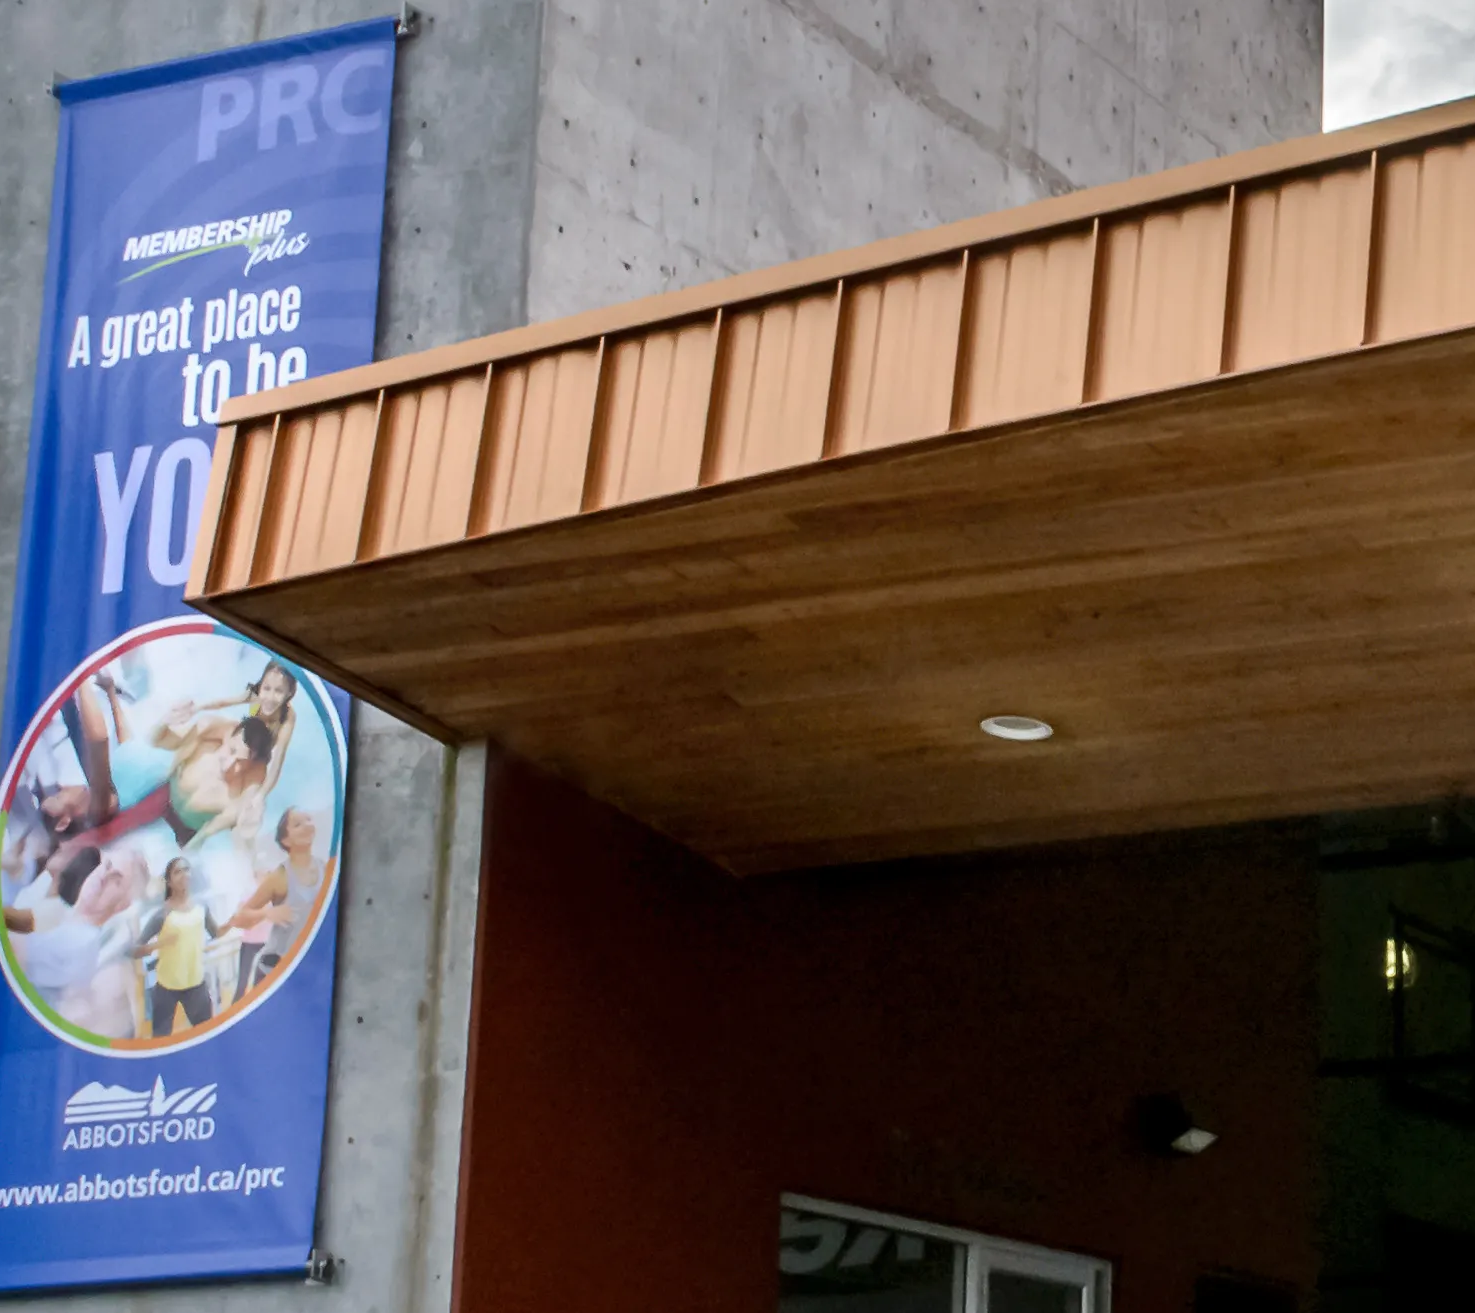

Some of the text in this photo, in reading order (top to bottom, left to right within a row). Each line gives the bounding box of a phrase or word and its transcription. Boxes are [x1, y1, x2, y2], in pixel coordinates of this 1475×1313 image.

[197, 48, 390, 163] PRC
[123, 208, 293, 262] MEMBERSHIP
[243, 228, 310, 277] plus
[67, 284, 302, 369] A great place
[182, 352, 232, 428] to
[62, 1116, 216, 1151] ABBOTSFORD
